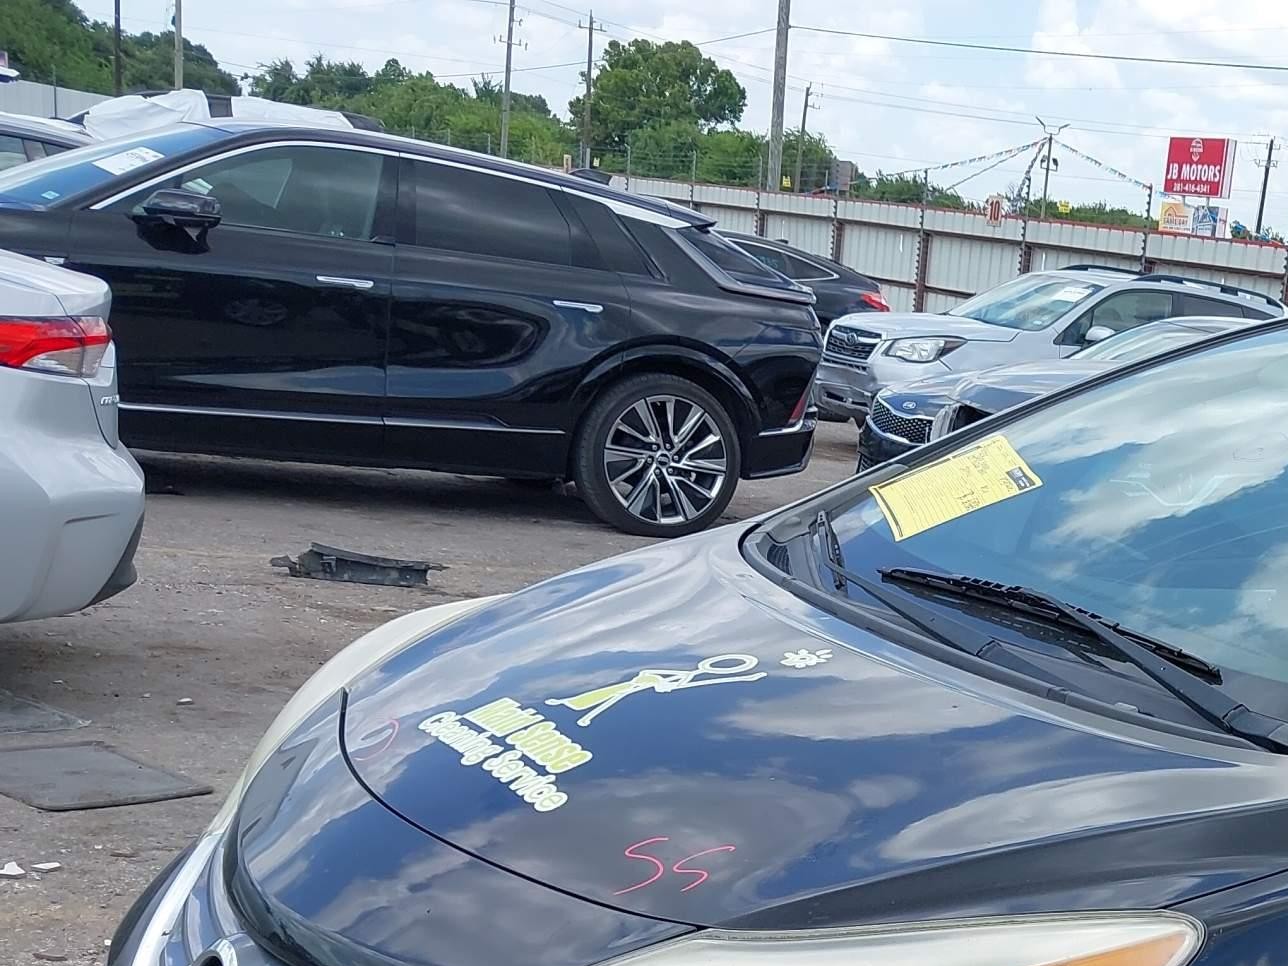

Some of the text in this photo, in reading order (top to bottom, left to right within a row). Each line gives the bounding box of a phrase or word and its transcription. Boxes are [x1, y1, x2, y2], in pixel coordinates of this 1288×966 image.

[1167, 163, 1221, 182] JB MOTORS
[482, 750, 569, 813] Service
